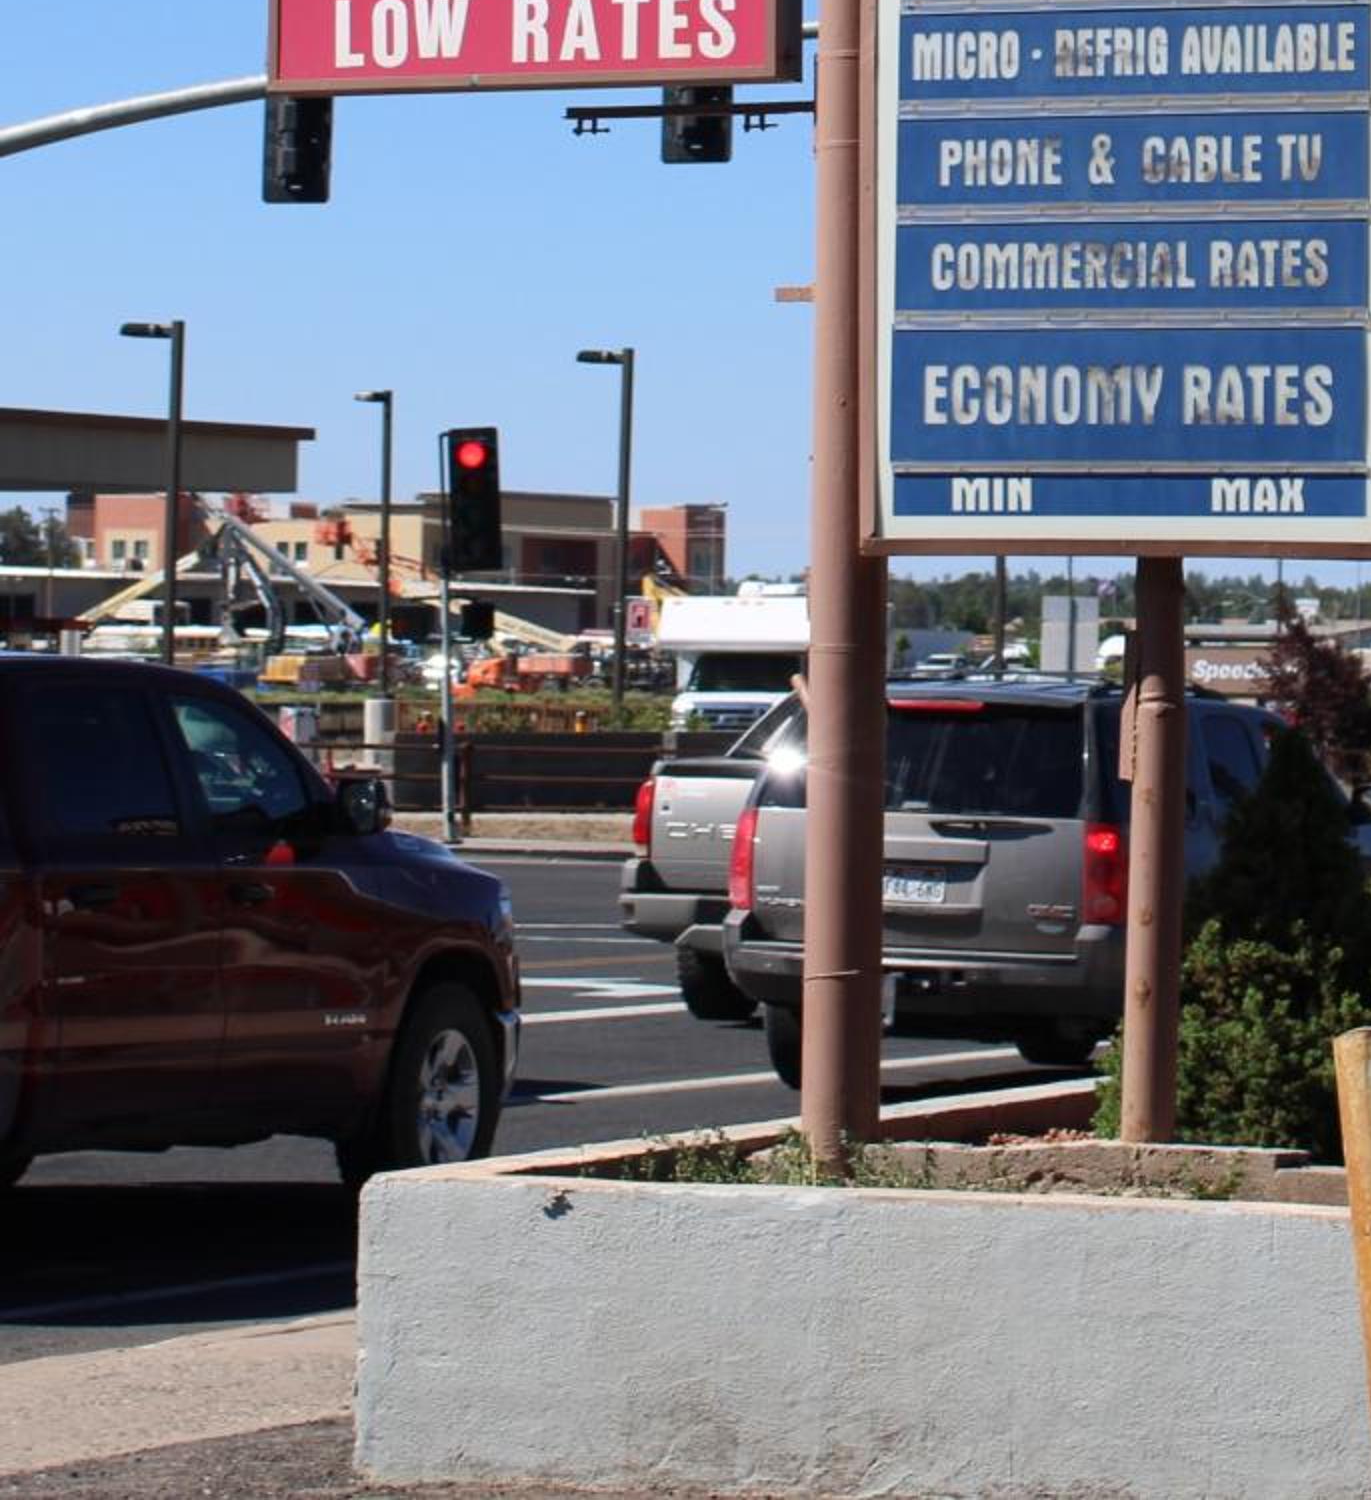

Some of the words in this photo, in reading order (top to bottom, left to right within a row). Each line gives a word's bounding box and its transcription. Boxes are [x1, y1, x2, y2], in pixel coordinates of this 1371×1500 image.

[912, 30, 1020, 82] MICRO
[1054, 26, 1169, 78] REFRIG
[1181, 21, 1356, 75] AVAILABLE
[939, 138, 1063, 188] PHONE
[1087, 133, 1116, 185] &
[1142, 134, 1263, 184] CABLE
[1277, 133, 1324, 182] TV
[931, 241, 1196, 292] COMMERCIAL
[1209, 239, 1330, 288] RATES
[923, 364, 1163, 426] ECONOMY
[1183, 364, 1334, 426] RATES
[951, 477, 1033, 513] MIN
[1211, 478, 1306, 514] MAX
